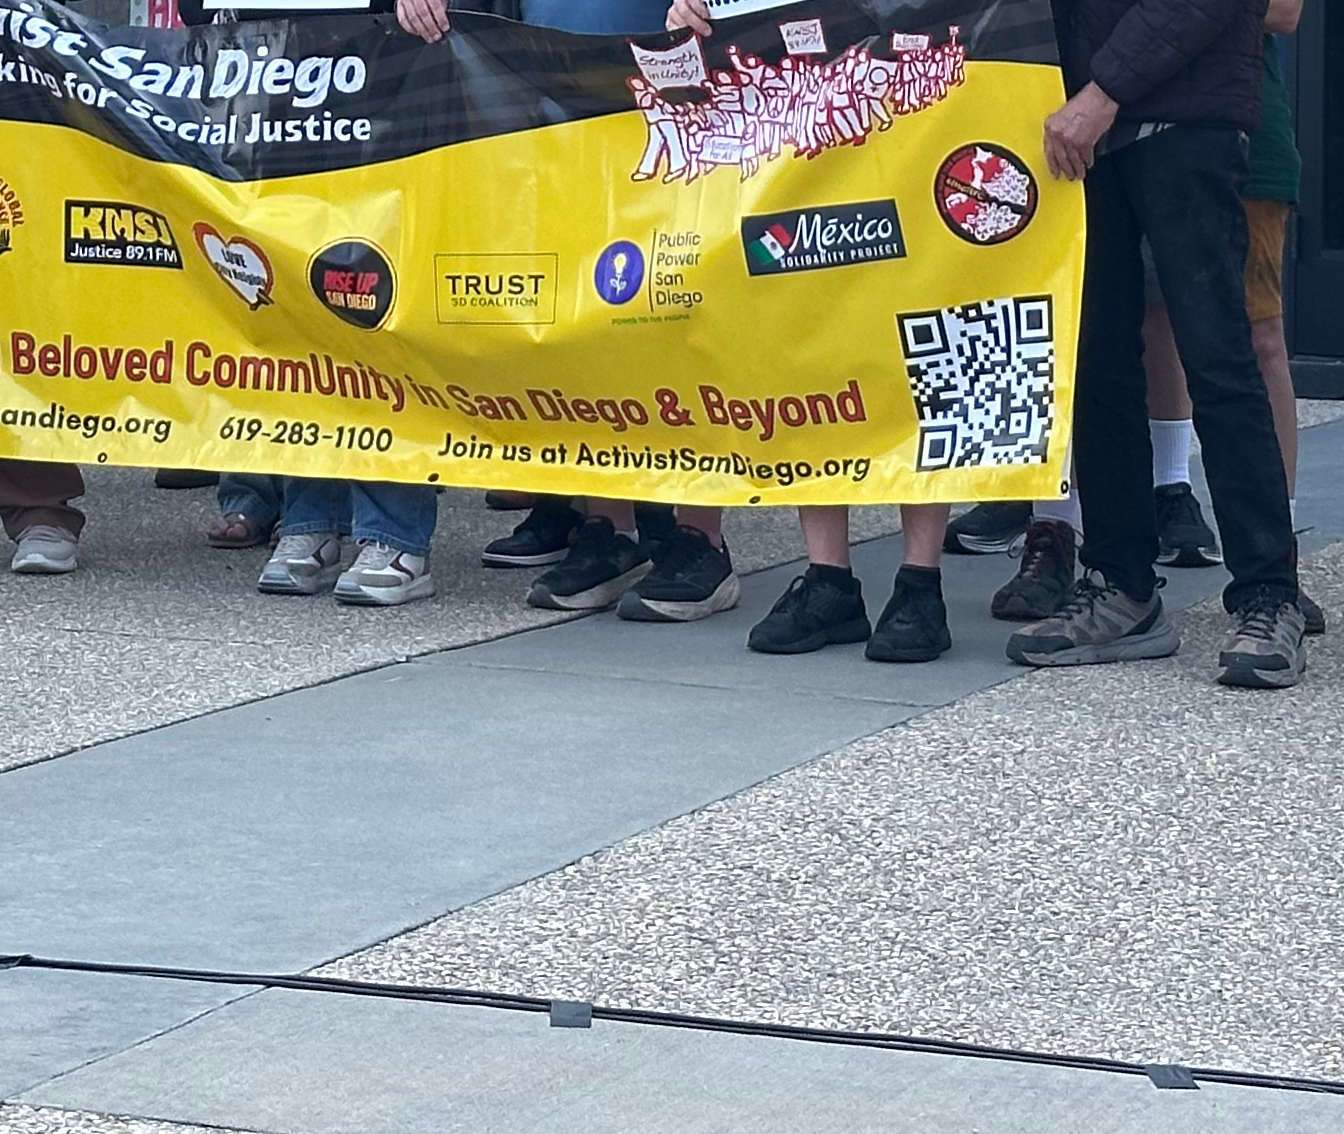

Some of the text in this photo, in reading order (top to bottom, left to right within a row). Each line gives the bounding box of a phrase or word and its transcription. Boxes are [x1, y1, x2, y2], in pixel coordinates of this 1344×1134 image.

[63, 72, 117, 108] for
[126, 99, 237, 145] Social
[245, 111, 372, 144] Justice
[658, 231, 702, 248] Public
[70, 243, 122, 259] Justice
[656, 252, 702, 267] Power
[850, 243, 899, 259] PROJECT
[355, 270, 380, 294] UP
[445, 275, 545, 296] TRUST
[655, 271, 684, 287] San
[346, 293, 377, 311] DIEGO
[470, 296, 539, 308] COALITION
[656, 289, 704, 308] Diego
[10, 330, 173, 386] Beloved
[186, 341, 407, 414] CommUnity
[408, 373, 449, 411] in
[452, 383, 528, 426] San
[530, 385, 648, 433] Diego
[656, 387, 694, 428] &
[698, 379, 867, 443] Beyond
[219, 415, 394, 453] 619-283-1100
[437, 433, 494, 460] Join
[501, 443, 532, 463] us
[540, 443, 567, 466] at
[575, 445, 871, 486] ActivistSanDiego.org
